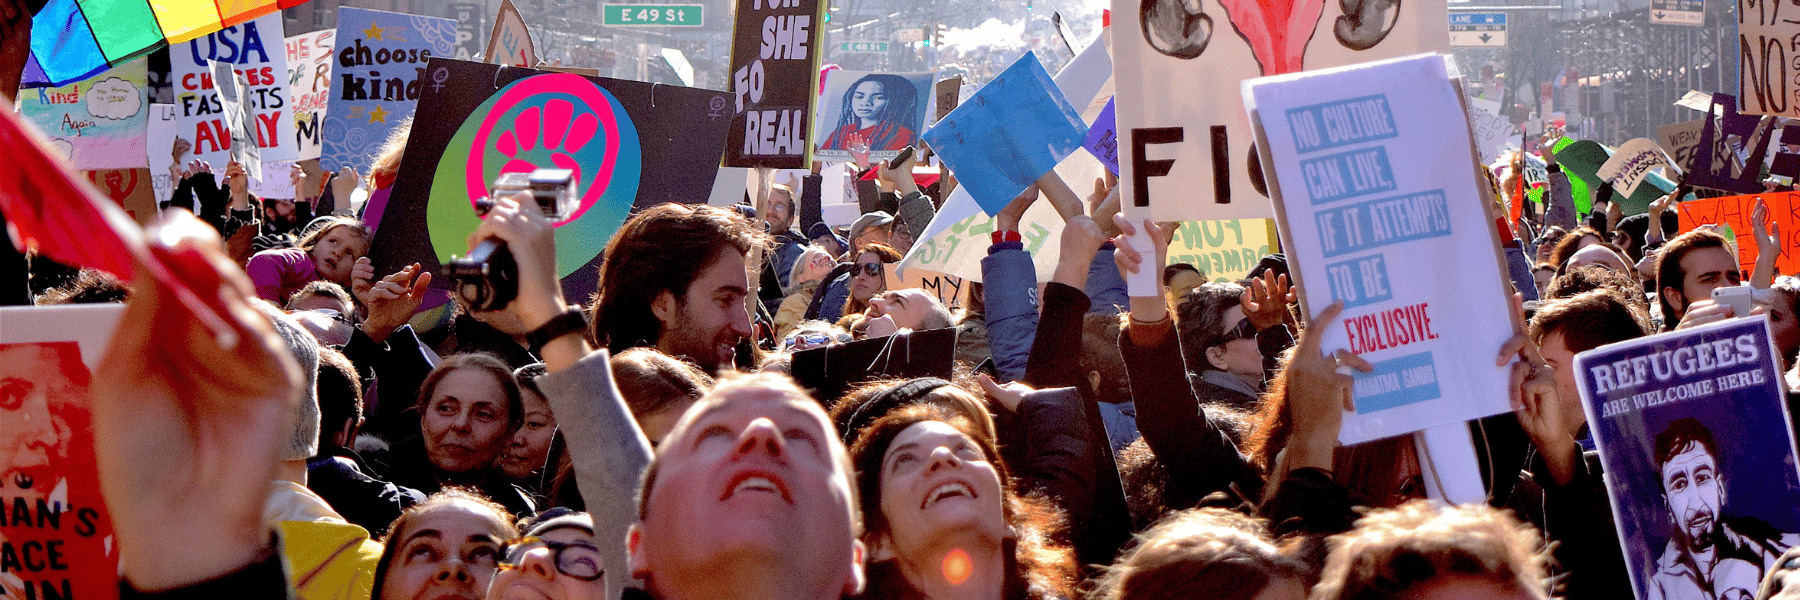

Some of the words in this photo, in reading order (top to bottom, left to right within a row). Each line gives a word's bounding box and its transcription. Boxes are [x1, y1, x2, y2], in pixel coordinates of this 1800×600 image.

[622, 9, 632, 22] E
[637, 9, 660, 22] 49
[666, 8, 686, 22] St
[1450, 15, 1471, 23] LANE
[190, 21, 270, 67] USA
[286, 38, 310, 61] HE
[339, 38, 432, 68] choose
[760, 15, 811, 60] SHE
[38, 84, 80, 105] Kind
[182, 66, 275, 91] CHES
[340, 66, 429, 102] kind
[734, 59, 765, 115] FO
[1739, 34, 1787, 113] NO
[61, 112, 96, 137] Again
[743, 109, 805, 156] REAL
[1289, 110, 1320, 150] NO
[1321, 98, 1394, 143] CULTURE
[1304, 158, 1347, 200] CAN
[1345, 151, 1393, 192] LIVE,
[1318, 212, 1336, 252] IF
[1342, 207, 1362, 247] IT
[1369, 192, 1448, 242] ATTEMPTS
[1681, 195, 1771, 229] WHO
[922, 276, 962, 304] MY
[1329, 263, 1357, 302] TO
[1359, 257, 1387, 299] BE
[1343, 302, 1440, 356] EXCLUSIVE.
[1355, 371, 1402, 398] MAHATMA
[1402, 364, 1437, 389] GANDHI
[1590, 333, 1759, 395] REFUGEES
[1602, 399, 1630, 418] ARE
[1632, 379, 1713, 410] WELCOME
[1716, 368, 1765, 392] HERE
[0, 496, 99, 538] AN'S
[0, 540, 69, 574] ACE
